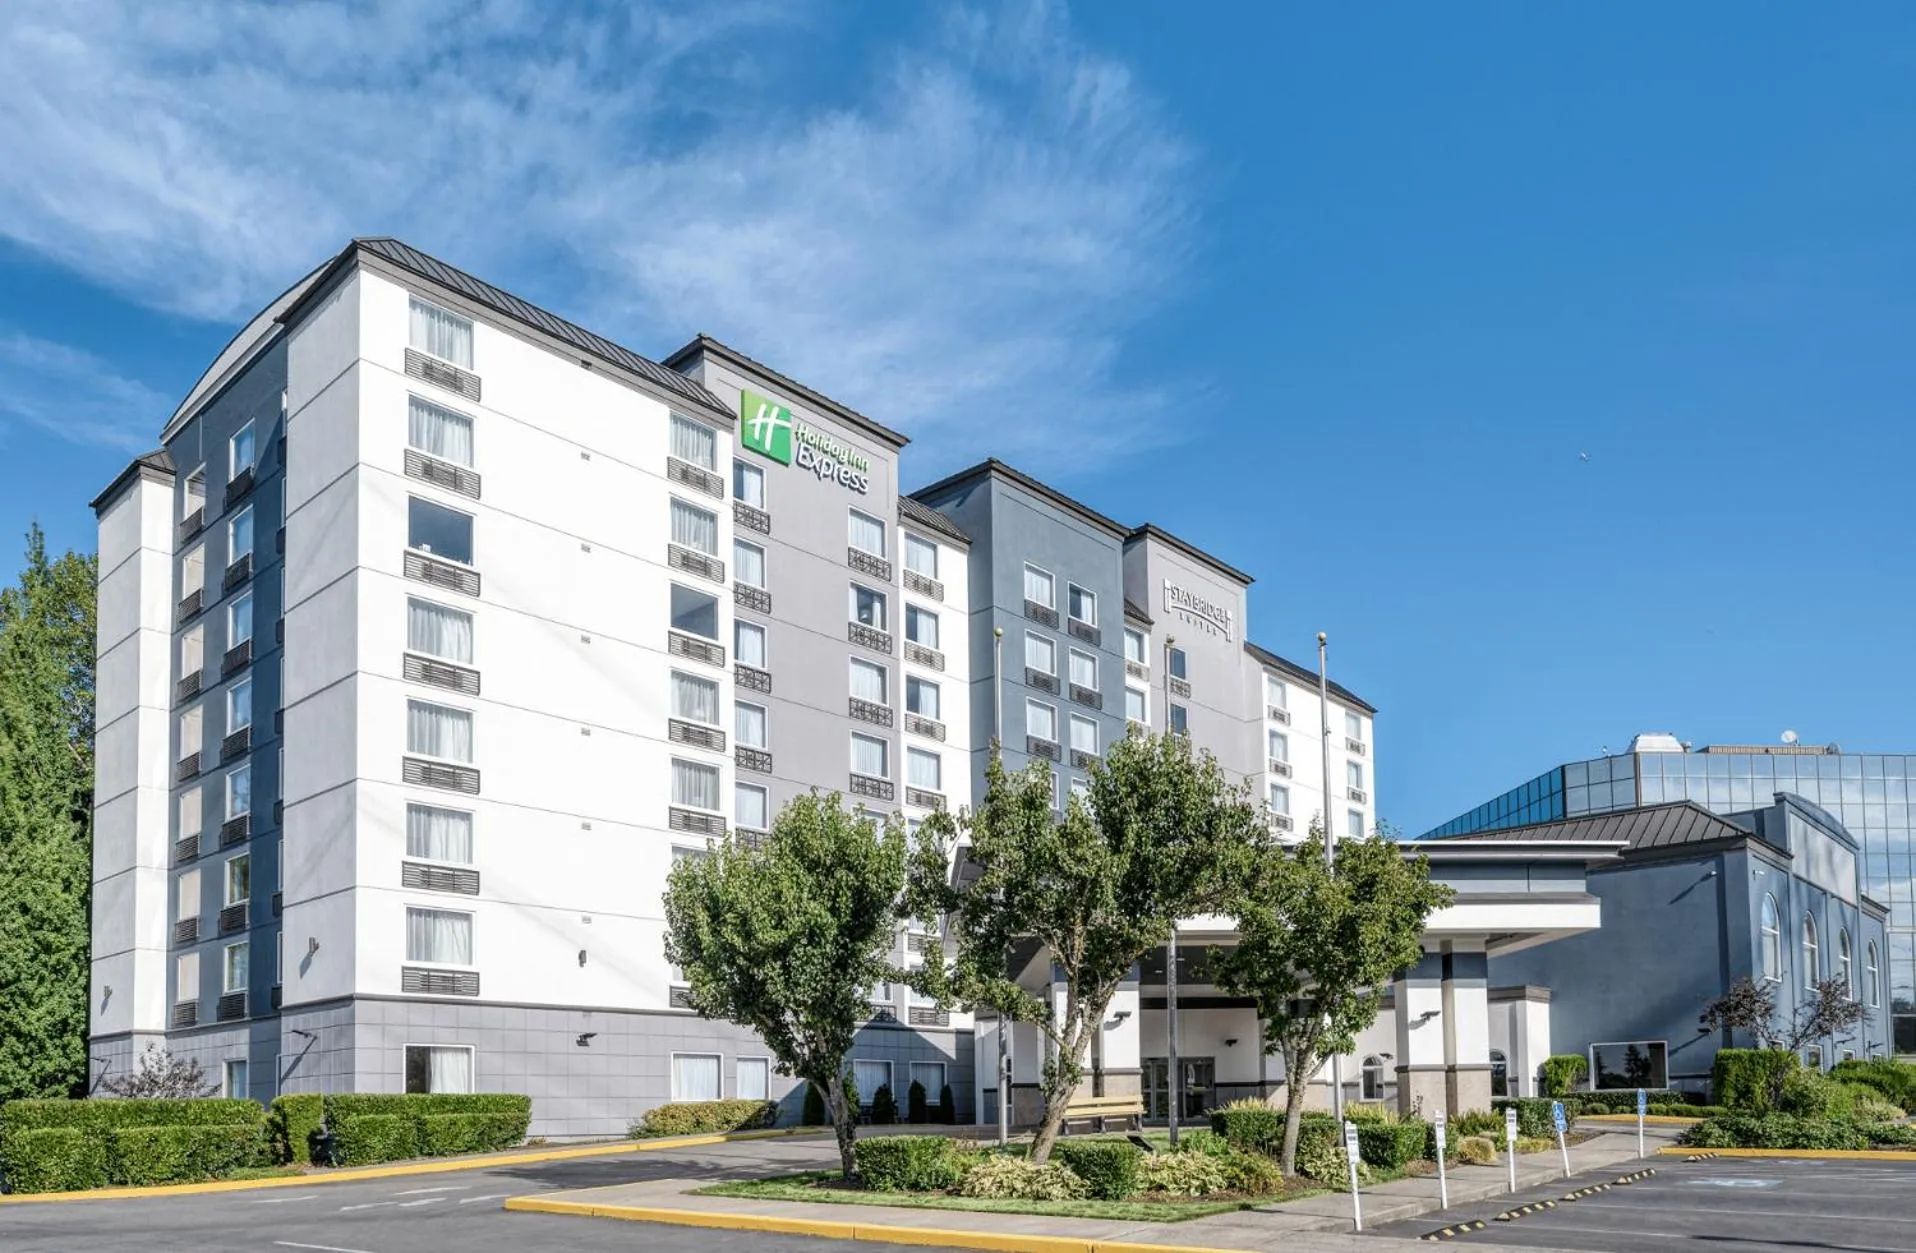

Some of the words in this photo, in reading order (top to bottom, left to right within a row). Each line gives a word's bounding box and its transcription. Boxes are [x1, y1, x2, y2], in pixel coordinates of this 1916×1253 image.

[797, 423, 849, 464] Holiday
[848, 447, 869, 472] Inn
[797, 443, 868, 495] Express
